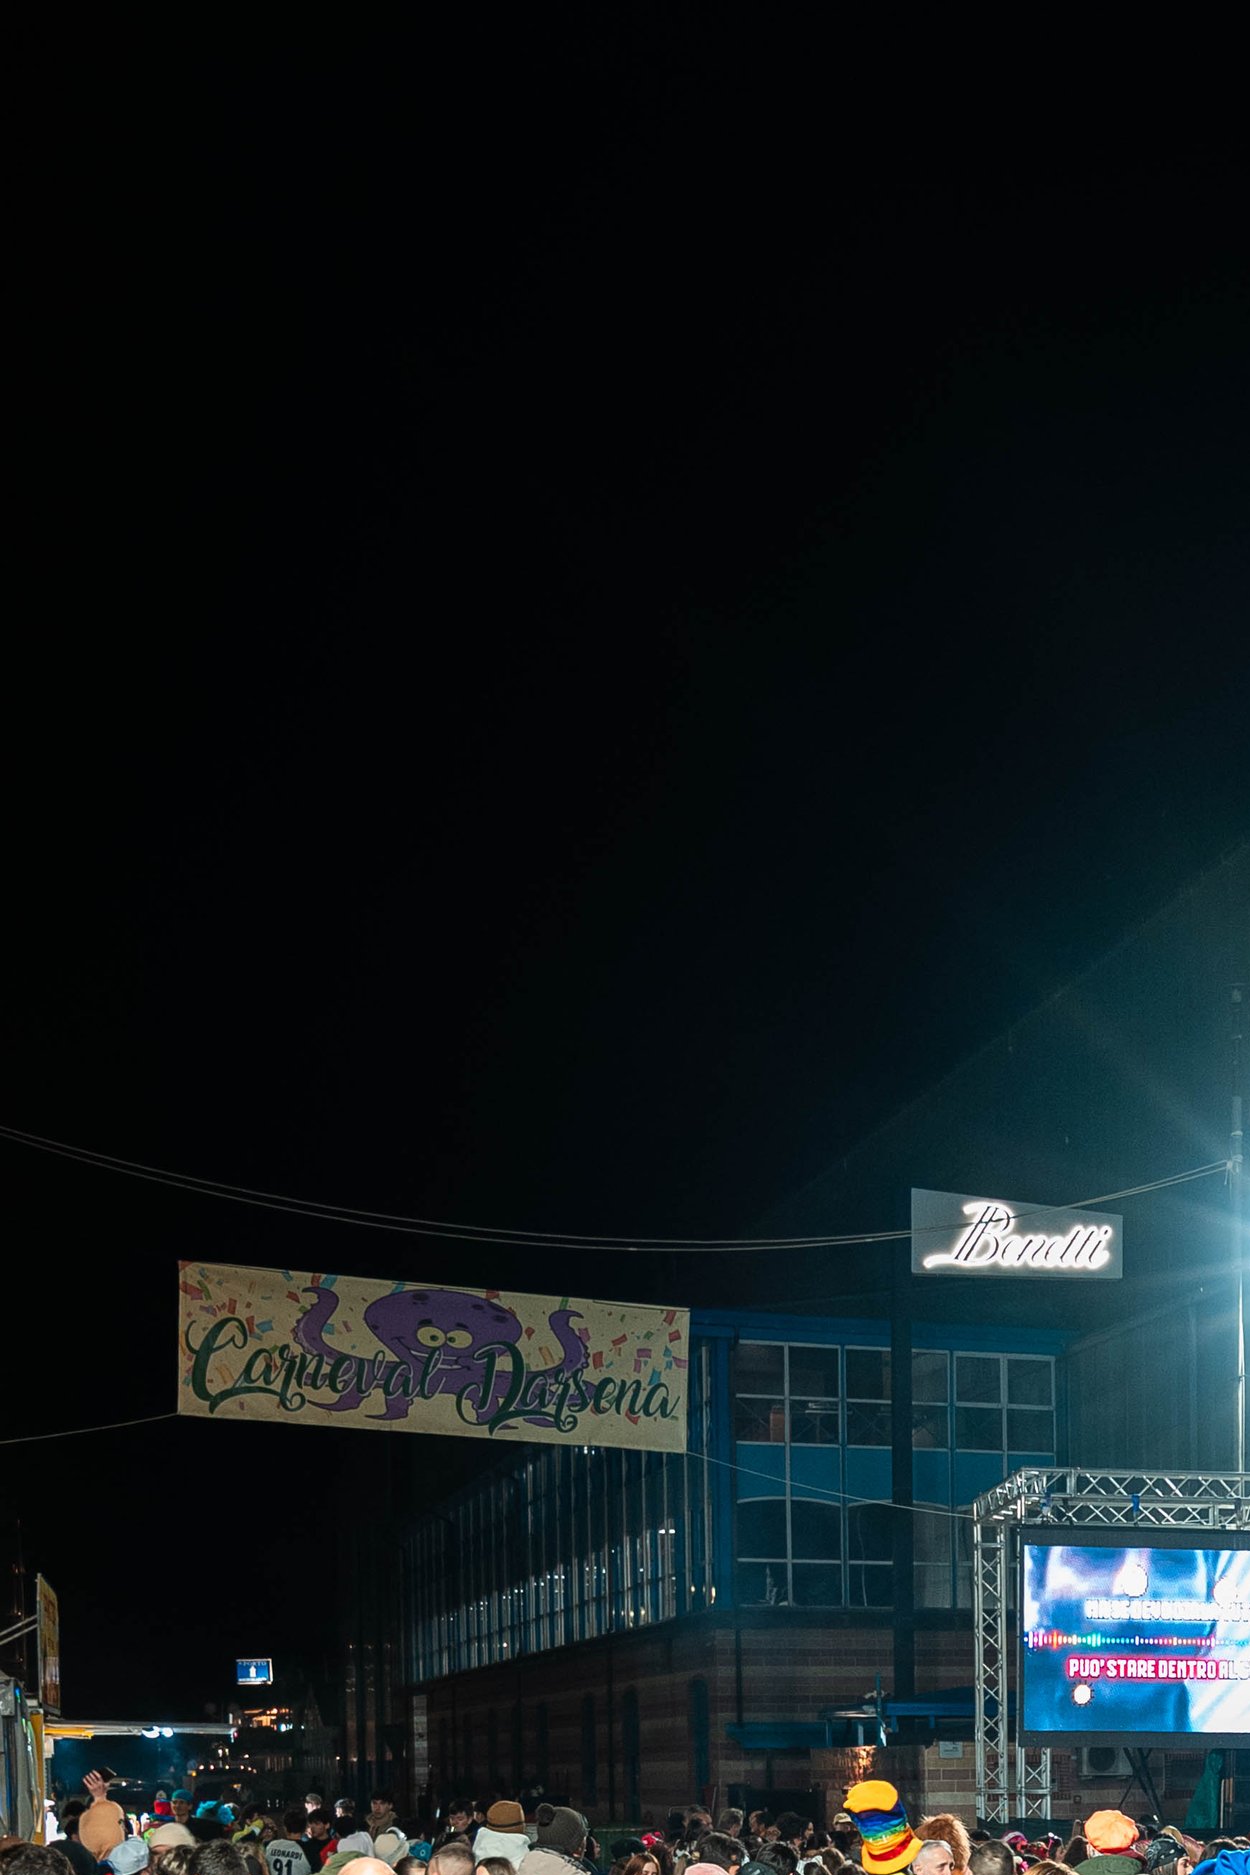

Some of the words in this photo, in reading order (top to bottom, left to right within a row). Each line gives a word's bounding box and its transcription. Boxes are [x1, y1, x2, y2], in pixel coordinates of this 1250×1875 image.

[185, 1316, 449, 1415] Carneval
[457, 1341, 680, 1436] Darsena
[1107, 1659, 1155, 1679] STARE
[1158, 1660, 1218, 1679] DENTRO
[270, 1849, 302, 1860] LEONARDI
